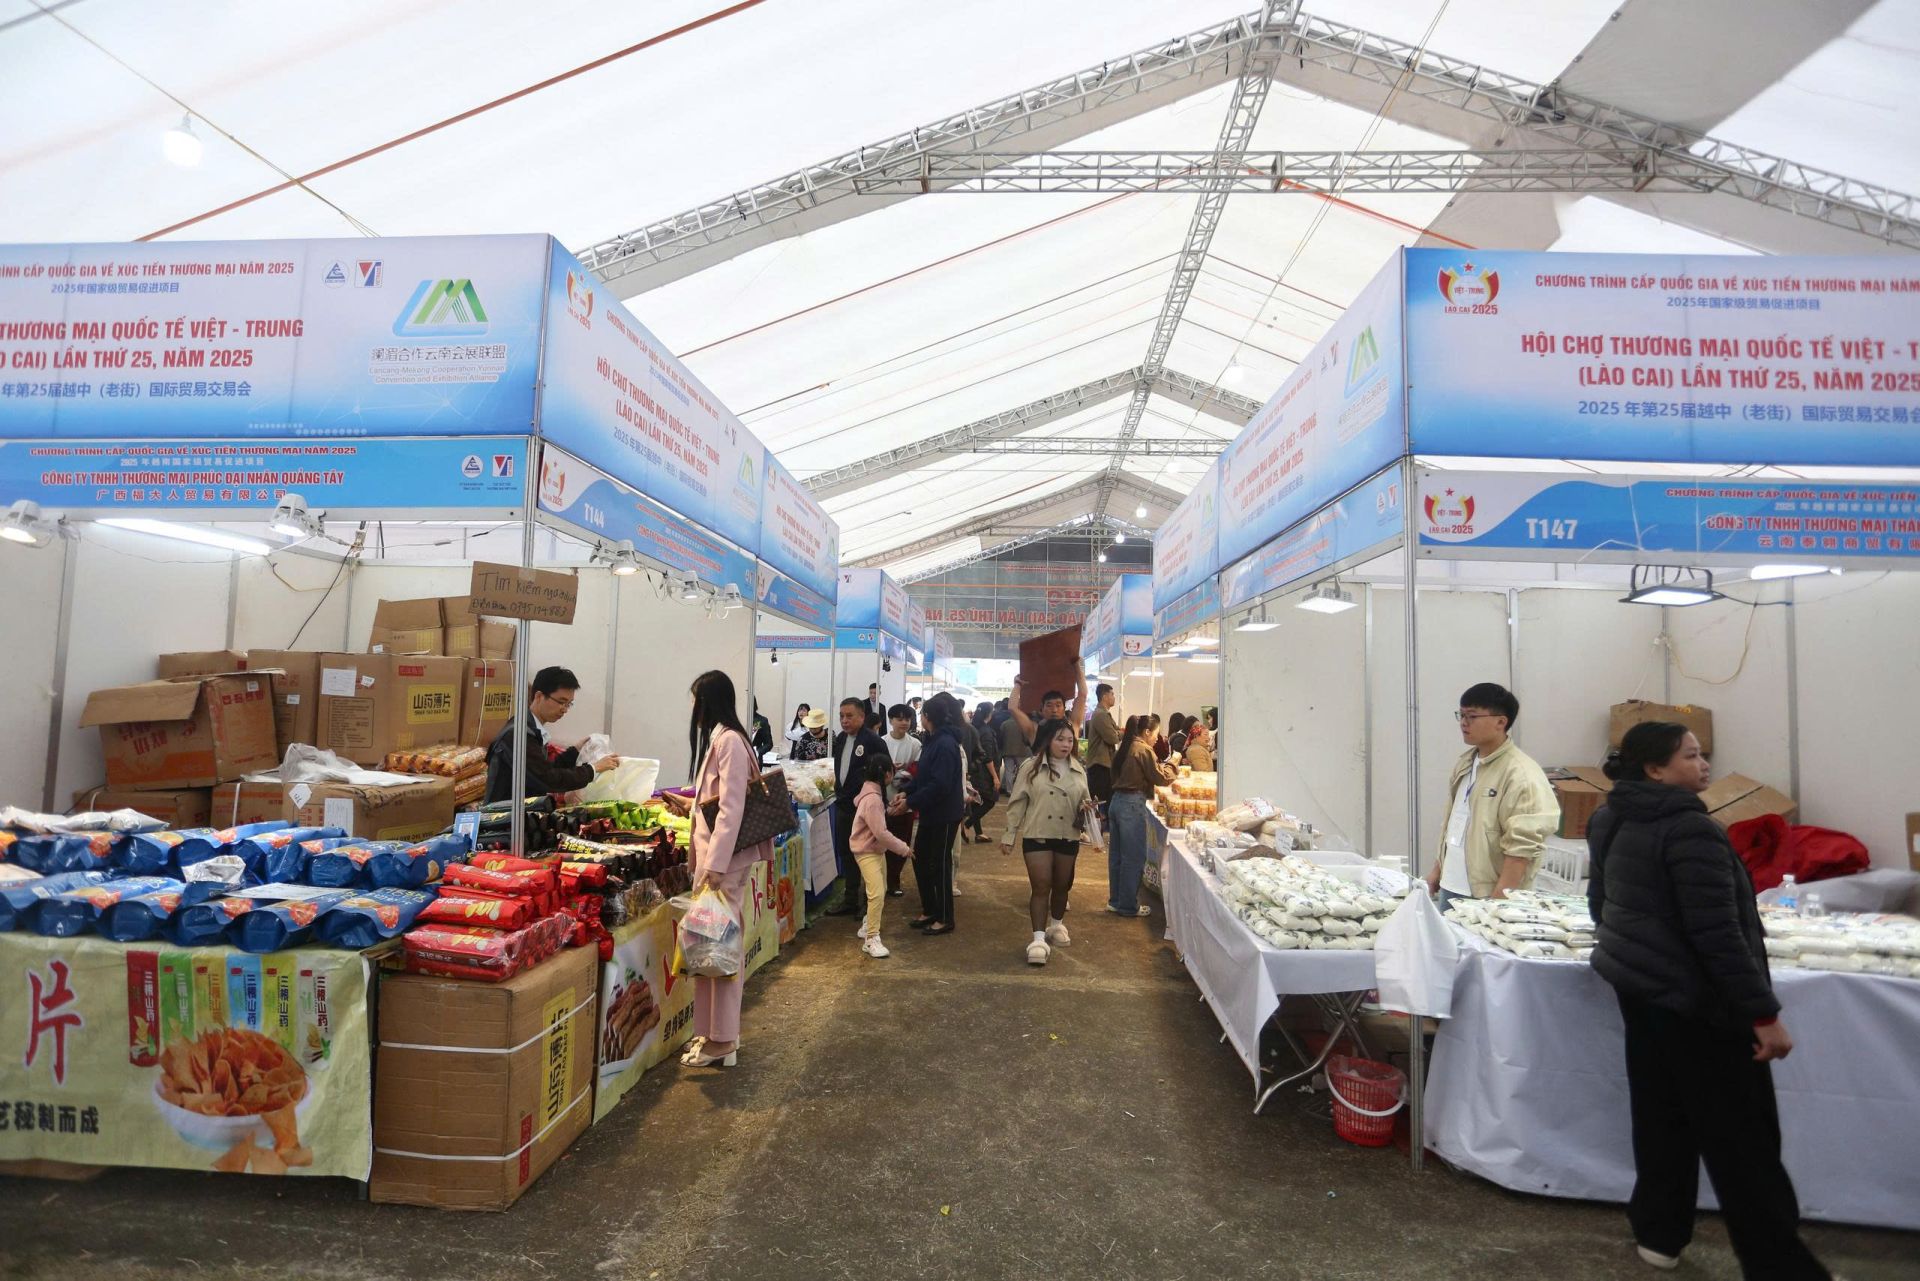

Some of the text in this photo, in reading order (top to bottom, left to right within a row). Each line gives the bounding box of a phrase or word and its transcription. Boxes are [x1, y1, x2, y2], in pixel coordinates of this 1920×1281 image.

[24, 264, 44, 277] CẤP
[48, 263, 76, 278] QUỐC
[80, 265, 97, 277] GIA
[102, 262, 114, 277] VỀ
[118, 263, 138, 276] XÚC
[143, 262, 166, 276] TIẾN
[170, 263, 211, 276] THƯƠNG
[215, 264, 236, 277] MẠI
[240, 262, 264, 275] NĂM
[268, 262, 294, 274] 2025
[51, 282, 180, 295] 2025年国家级贸易促进项目
[1536, 273, 1920, 294] CHƯƠNG TRÌNH CẤP QUỐC GIA VỀ XÚC TIẾN THƯƠNG MẠI NĂM
[1472, 304, 1498, 315] 2025
[1667, 296, 1820, 310] 2025年国家级贸易促进项目
[0, 321, 66, 340] THƯƠNG
[72, 322, 105, 343] MẠI
[112, 316, 158, 340] QUỐC
[164, 316, 186, 338] TẾ
[190, 318, 228, 342] VIỆT
[246, 319, 304, 338] TRUNG
[372, 345, 506, 361] 澜湄合作云南会展联盟
[1522, 330, 1556, 358] HỘI
[1562, 334, 1604, 359] CHỢ
[1610, 336, 1692, 357] THƯƠNG
[1698, 338, 1739, 362] MẠI
[1746, 333, 1803, 360] QUỐC
[1810, 334, 1834, 360] TẾ
[1840, 338, 1885, 364] VIỆT
[12, 350, 46, 370] CAI)
[53, 345, 88, 368] LẦN
[93, 348, 128, 368] THỨ
[132, 350, 156, 370] 25,
[163, 347, 204, 368] NĂM
[210, 350, 252, 368] 2025
[597, 356, 611, 382] HỘI
[612, 370, 628, 396] CHỢ
[629, 382, 654, 414] THƯƠNG
[1579, 362, 1920, 392] (LÀO CAI) LẦN THỨ 25, NĂM 2025
[1578, 400, 1620, 416] 2025
[42, 468, 344, 488] CÔNG TY TNHH THƯƠNG MẠI PHÚC ĐẠI NHÂN QUẢNG TÂY
[584, 503, 604, 529] T144
[1706, 514, 1744, 530] CÔNG
[1747, 517, 1762, 530] TY
[1766, 517, 1800, 530] TNHH
[1804, 518, 1857, 531] THƯƠNG
[1861, 519, 1887, 534] MẠI
[1452, 524, 1474, 534] 2025
[1526, 518, 1578, 540] T147
[414, 693, 450, 710] 山药薄片
[26, 960, 82, 1085] 片
[548, 1008, 564, 1120] 山药薄片
